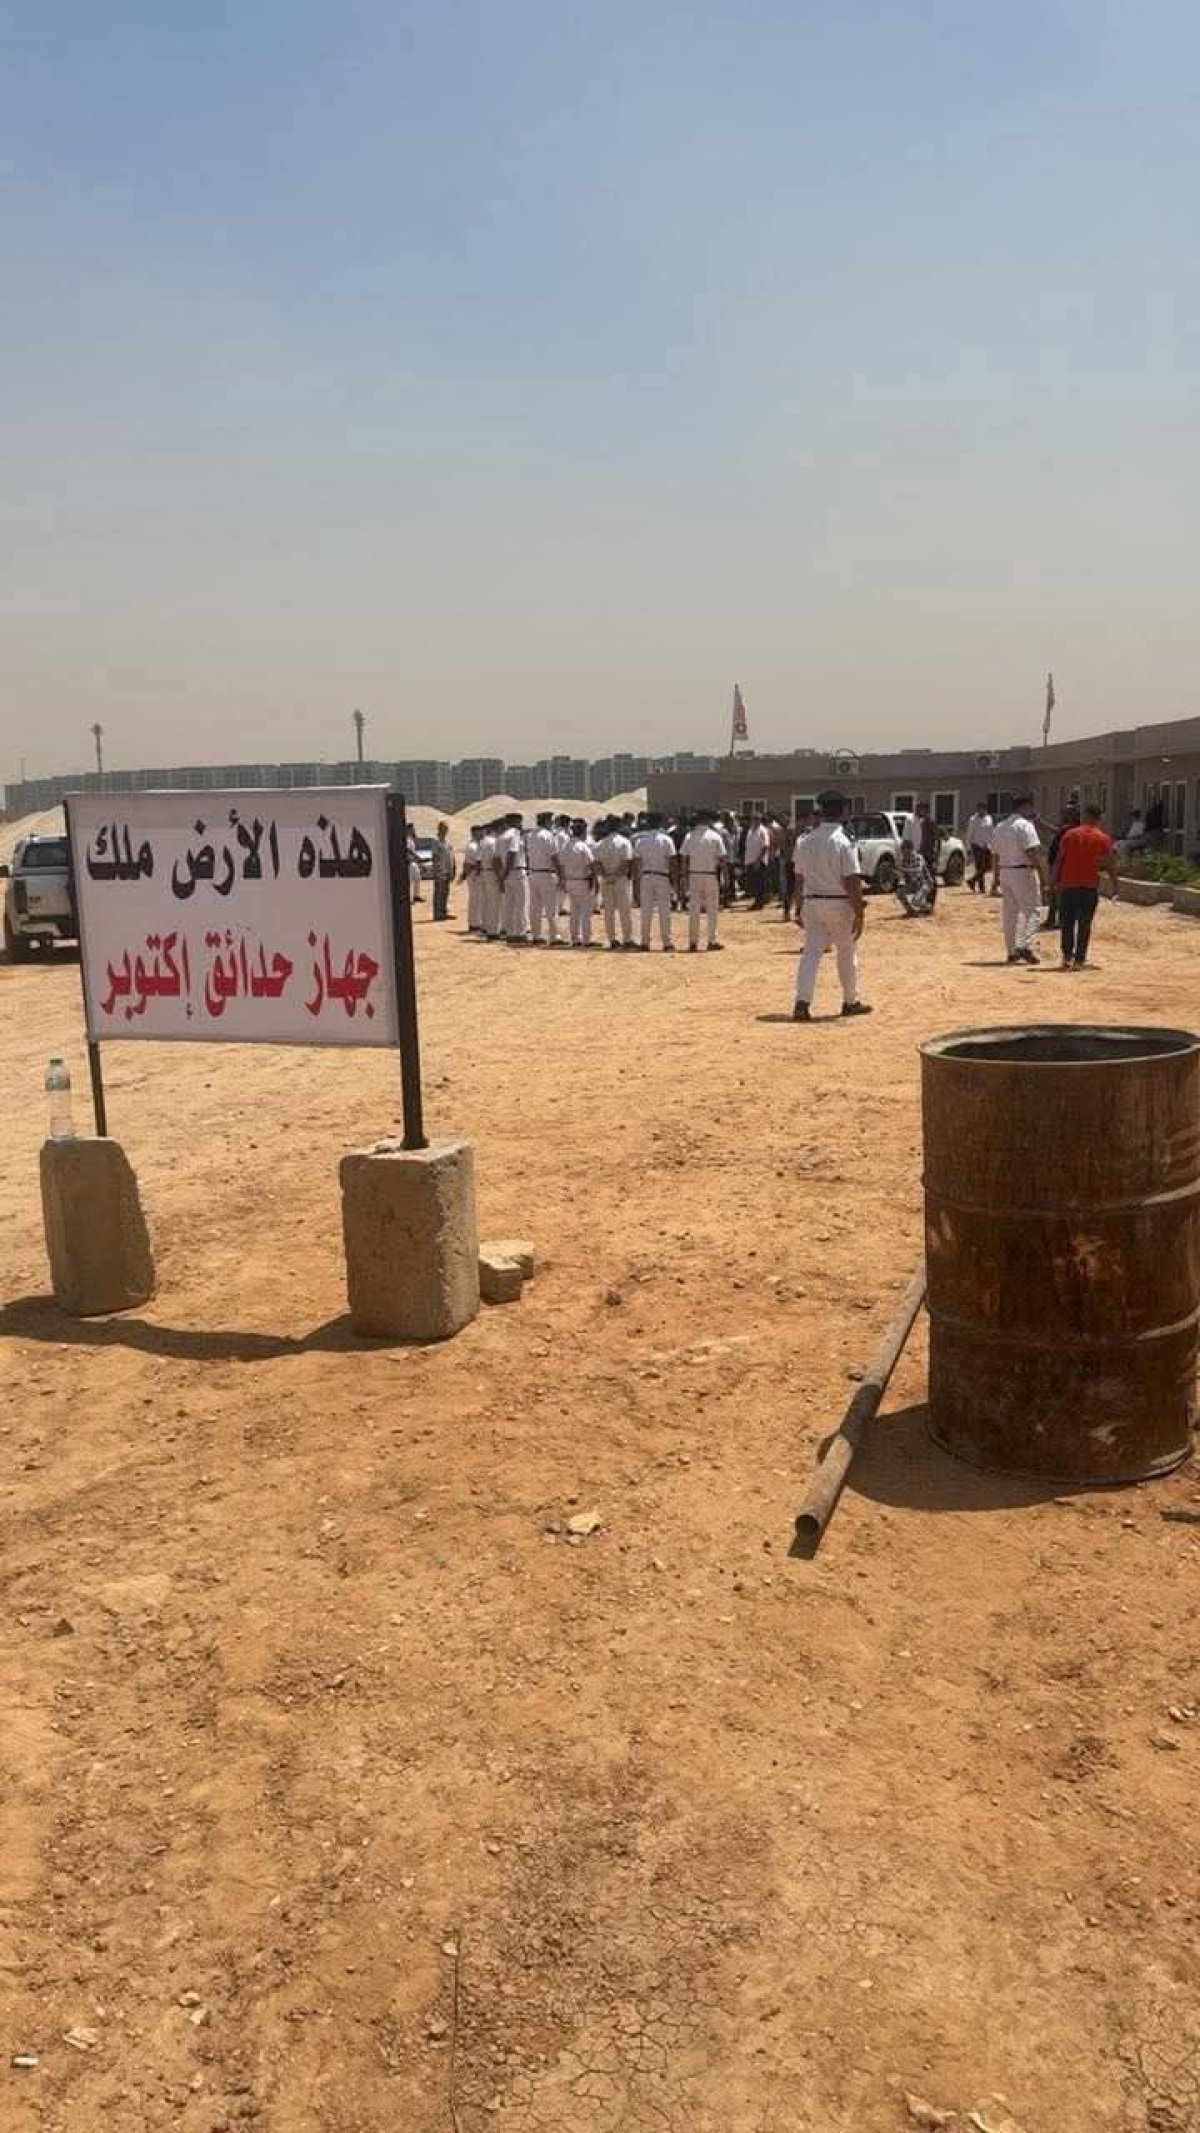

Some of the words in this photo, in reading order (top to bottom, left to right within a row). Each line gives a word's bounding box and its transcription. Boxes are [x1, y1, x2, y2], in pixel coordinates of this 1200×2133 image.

[86, 823, 154, 880] ملك
[171, 808, 280, 899] الأرض
[298, 814, 372, 879] هذه
[204, 928, 293, 1018] حدائق
[304, 929, 379, 1018] جهاز
